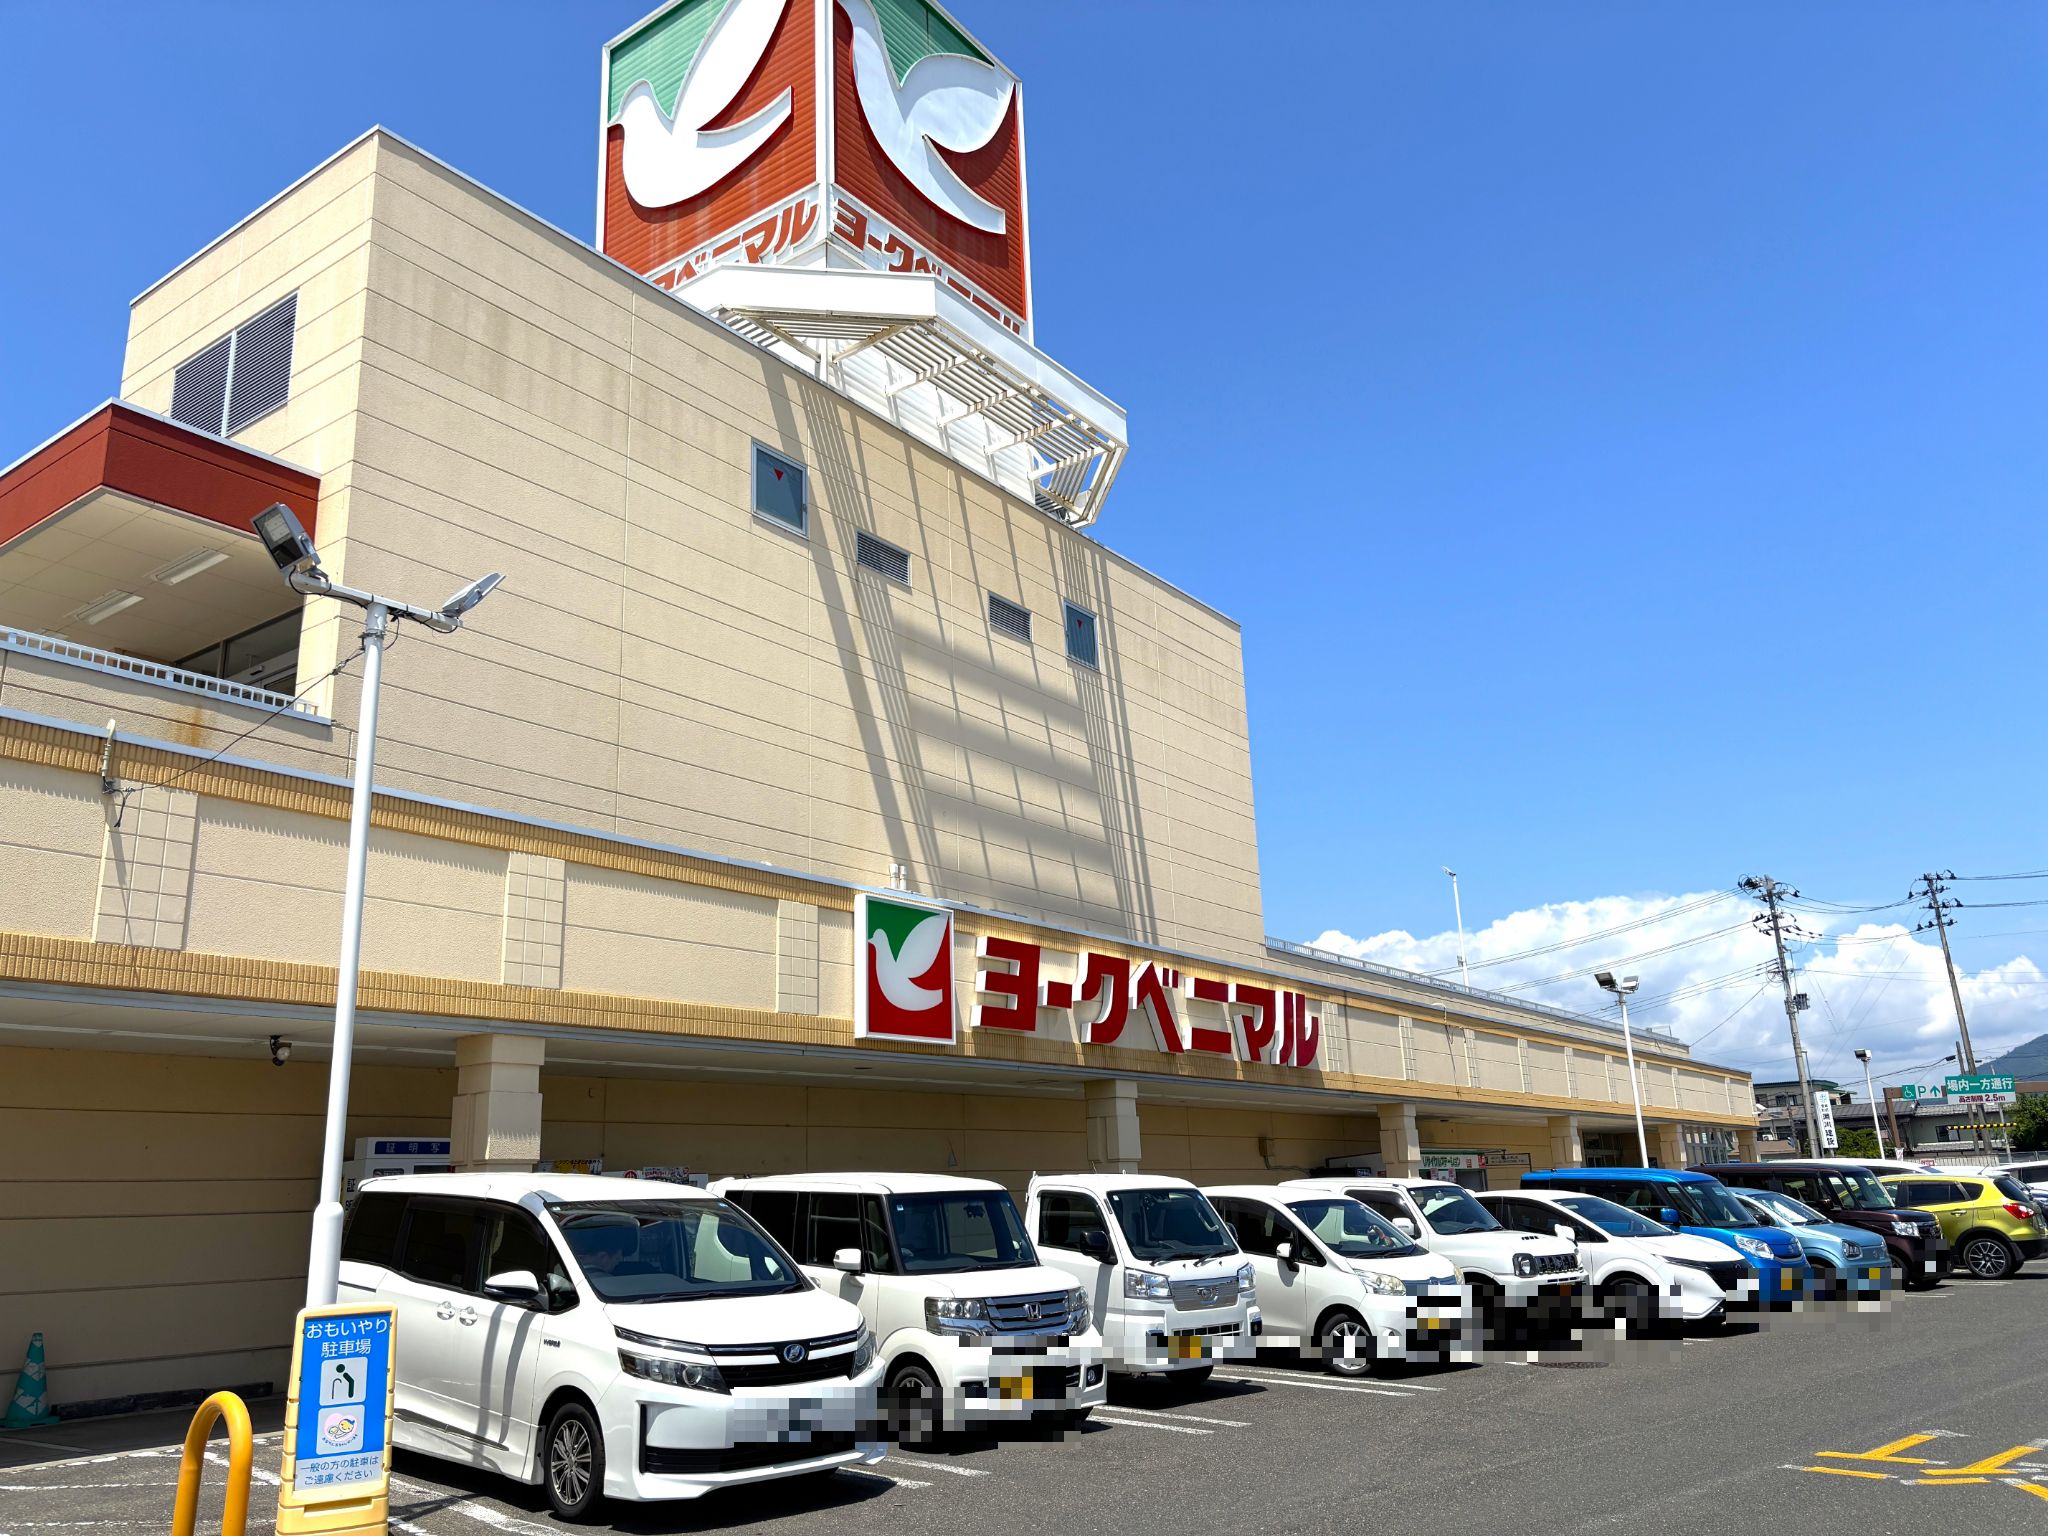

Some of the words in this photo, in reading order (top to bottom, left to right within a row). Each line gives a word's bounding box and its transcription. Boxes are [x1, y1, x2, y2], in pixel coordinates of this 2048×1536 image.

[973, 936, 1319, 1068] ヨークベニマル
[1946, 1078, 2012, 1092] 場内一方通行
[306, 1318, 388, 1339] おもいやり
[320, 1338, 372, 1358] 駐車場
[300, 1455, 379, 1473] 一般の方の駐車は
[304, 1469, 373, 1486] ご遠慮ください
